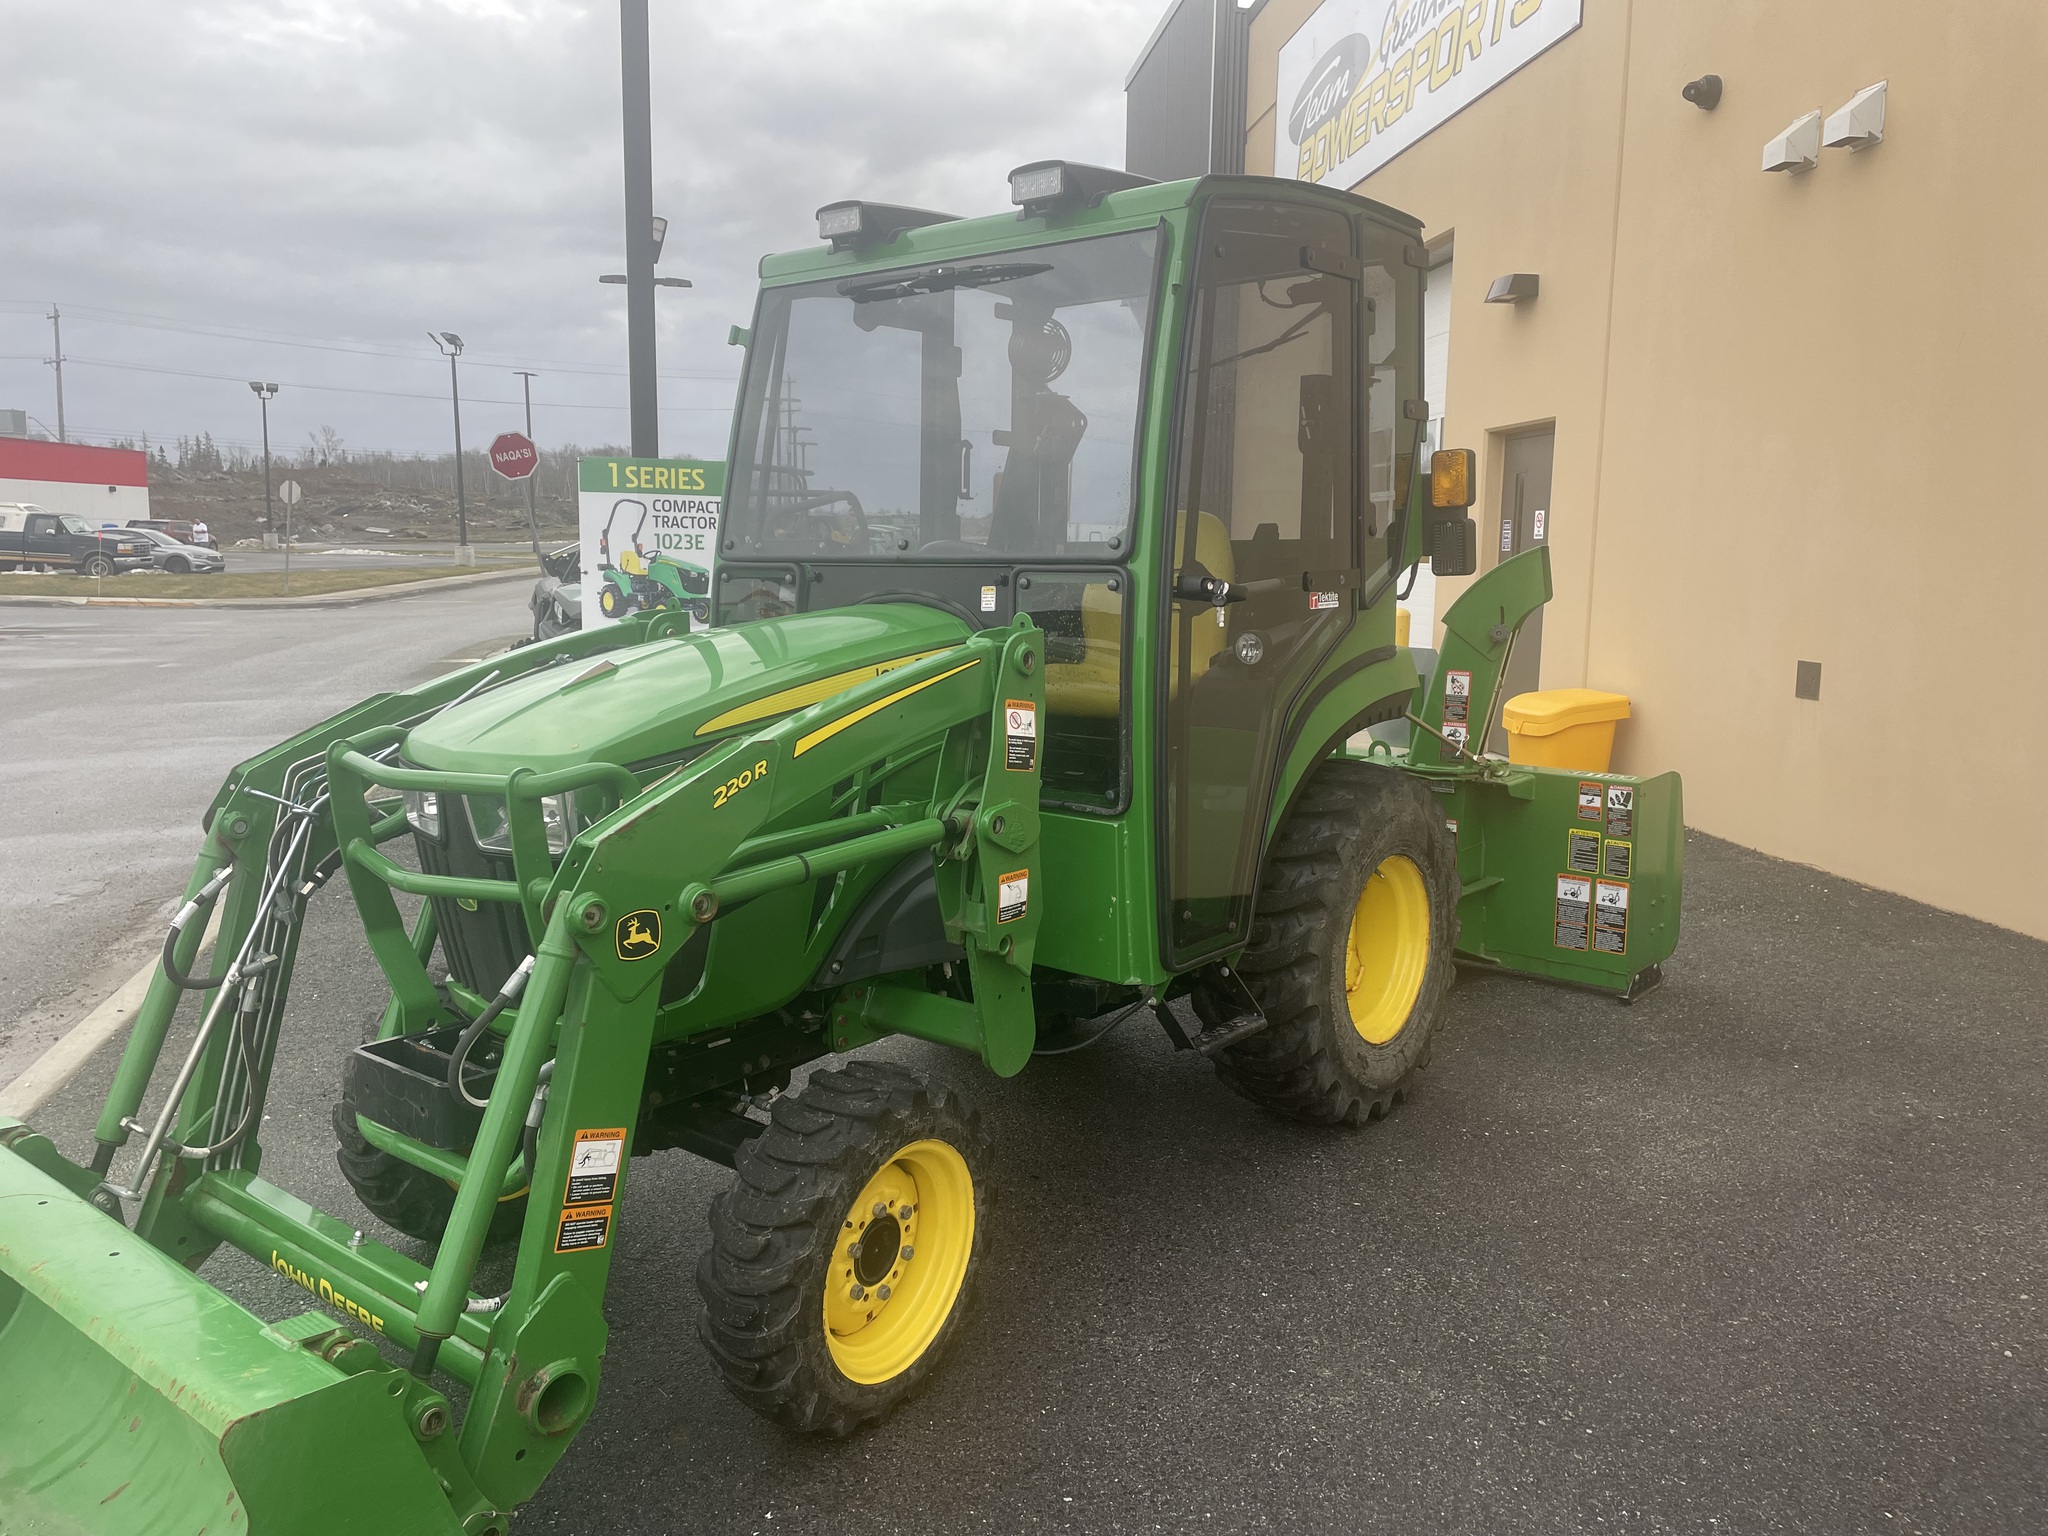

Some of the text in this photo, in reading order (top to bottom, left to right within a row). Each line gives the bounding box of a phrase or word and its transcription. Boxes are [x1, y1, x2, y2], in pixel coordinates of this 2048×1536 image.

[1290, 55, 1350, 146] Team
[495, 448, 532, 463] NAQA'SI
[608, 462, 705, 491] 1 SERIES
[652, 499, 721, 514] COMPACT
[652, 515, 717, 530] TRACTOR
[654, 533, 705, 550] 1023E
[1012, 702, 1035, 710] WARNING
[713, 759, 768, 810] 220 R
[1004, 870, 1027, 881] WARNING
[589, 1131, 620, 1139] WARNING
[575, 1208, 606, 1218] WARNING
[269, 1249, 387, 1338] JOHN DEERE
